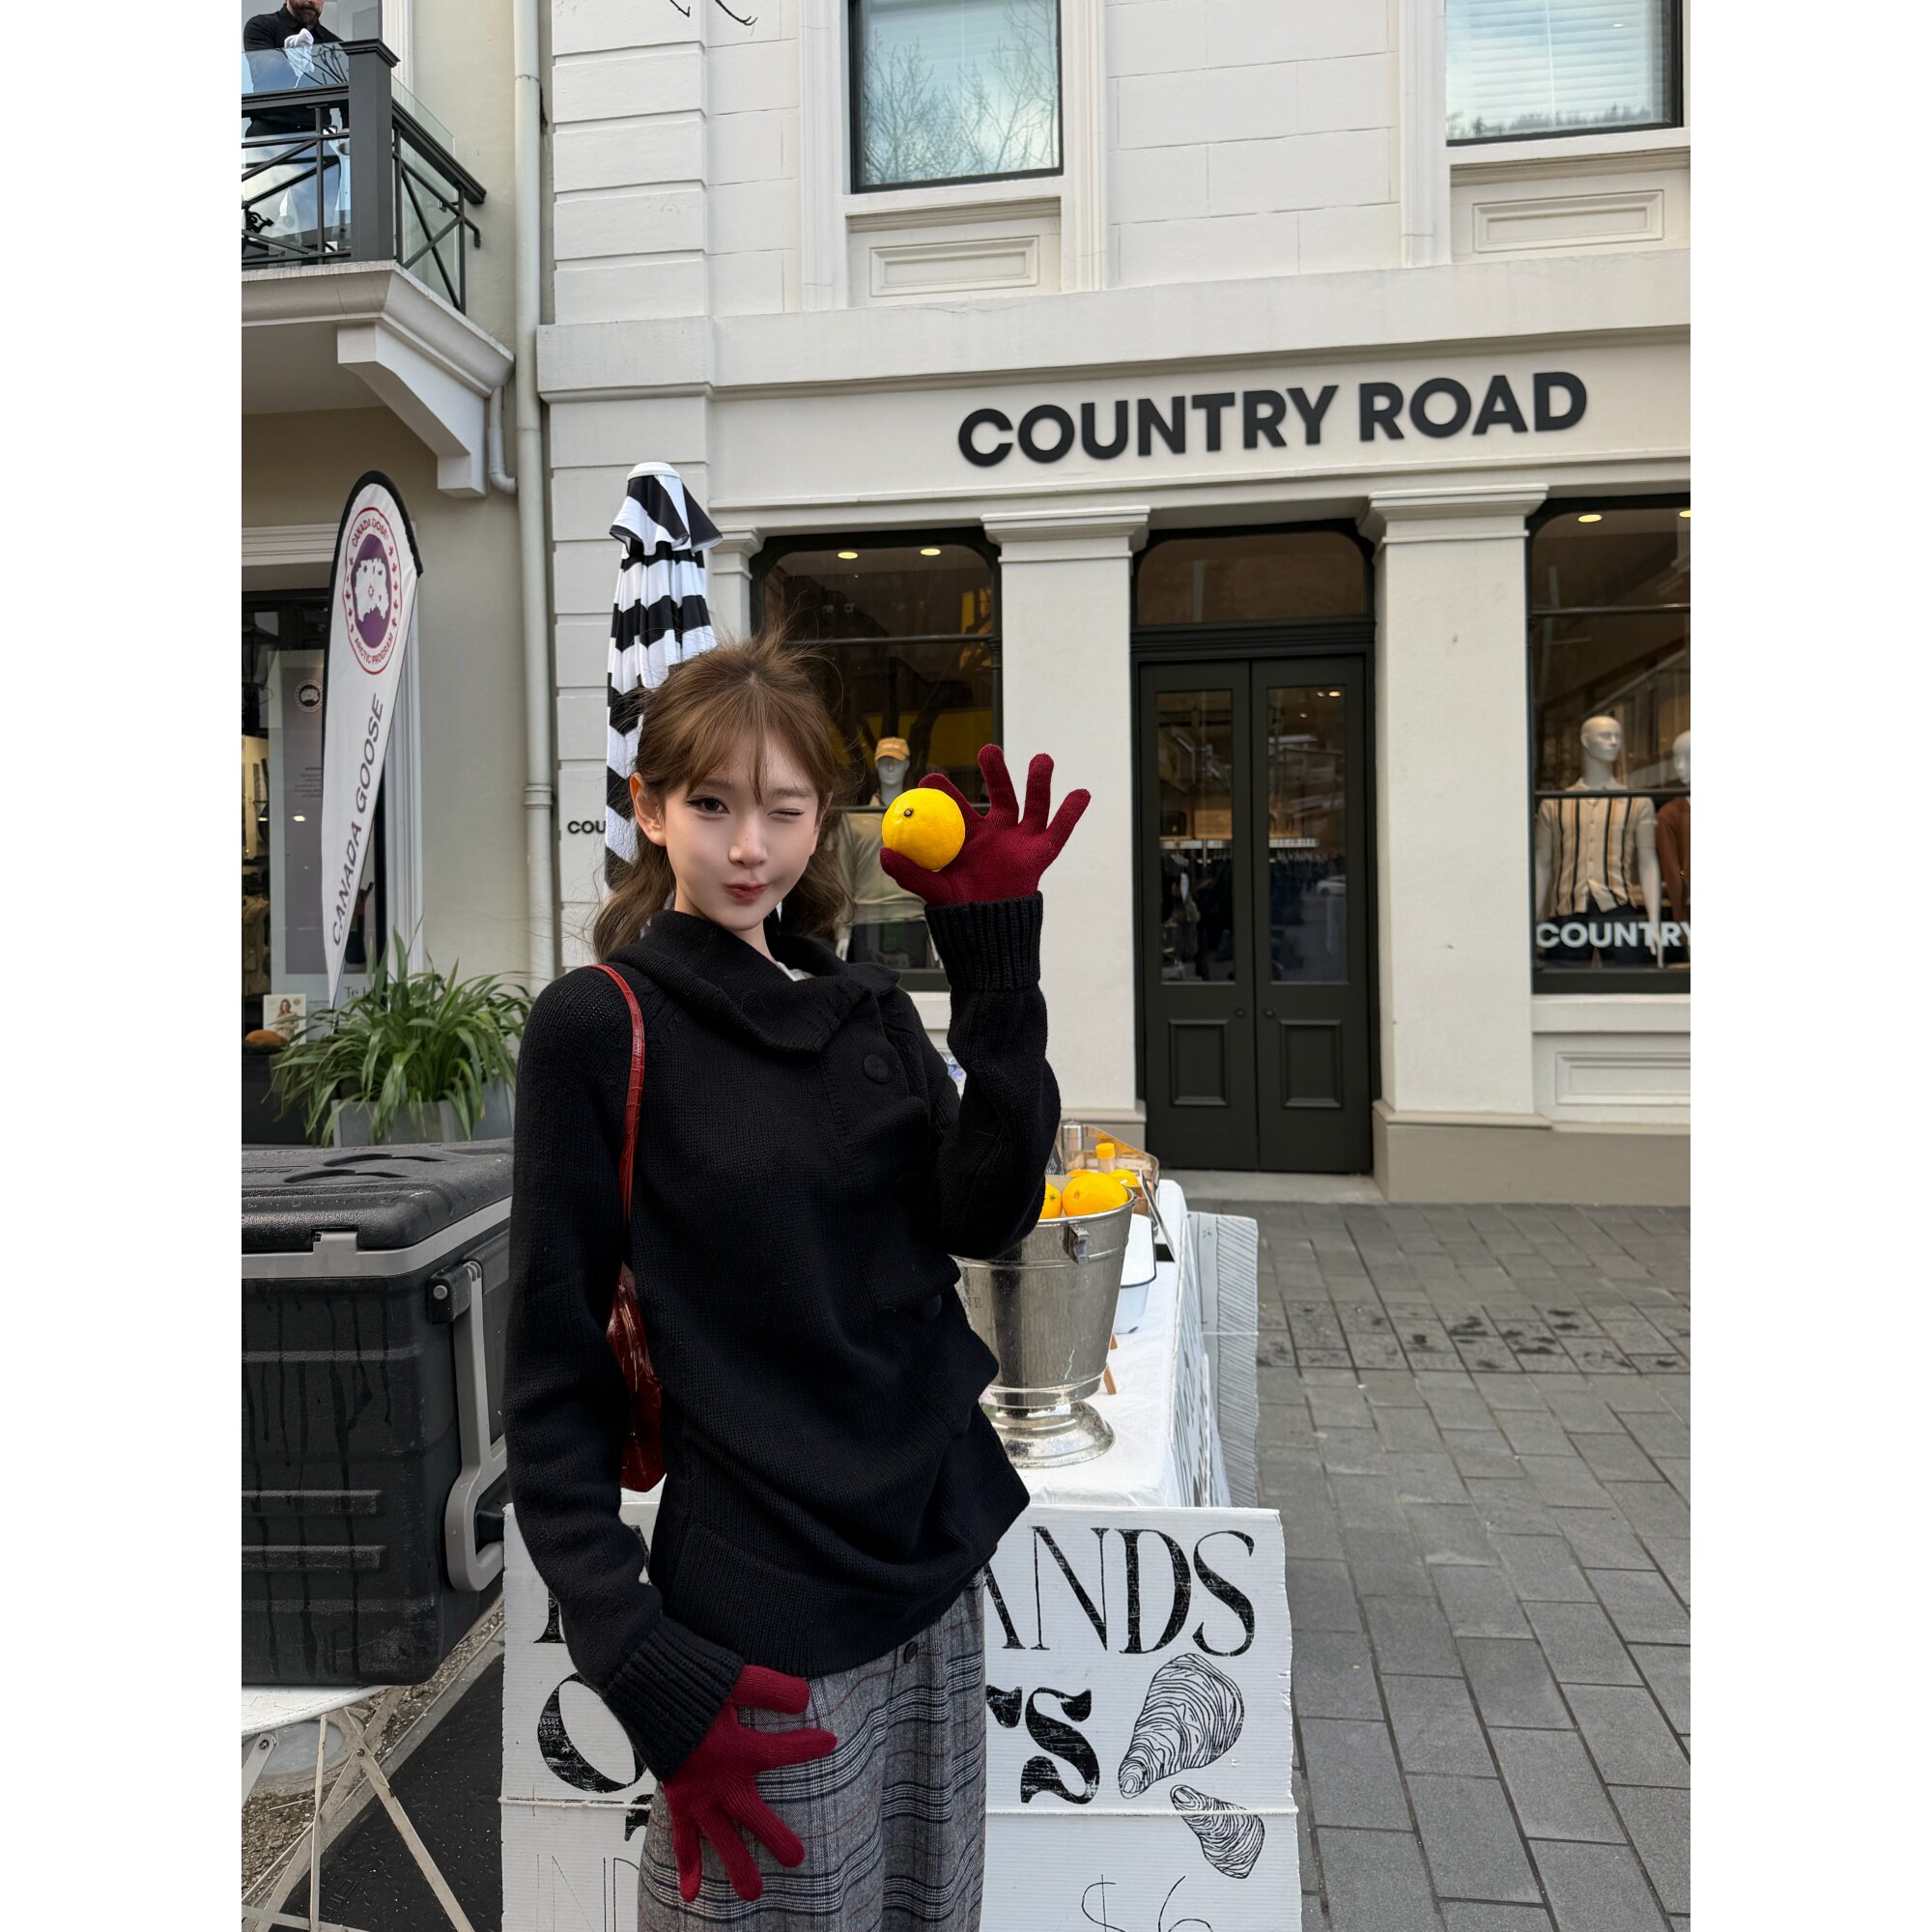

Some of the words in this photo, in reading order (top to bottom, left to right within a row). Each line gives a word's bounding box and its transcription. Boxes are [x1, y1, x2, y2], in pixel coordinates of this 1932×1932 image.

[957, 384, 1339, 468] COUNTRY
[1358, 371, 1587, 441] ROAD
[332, 821, 362, 946] CANADA
[355, 693, 384, 814] GOOSE
